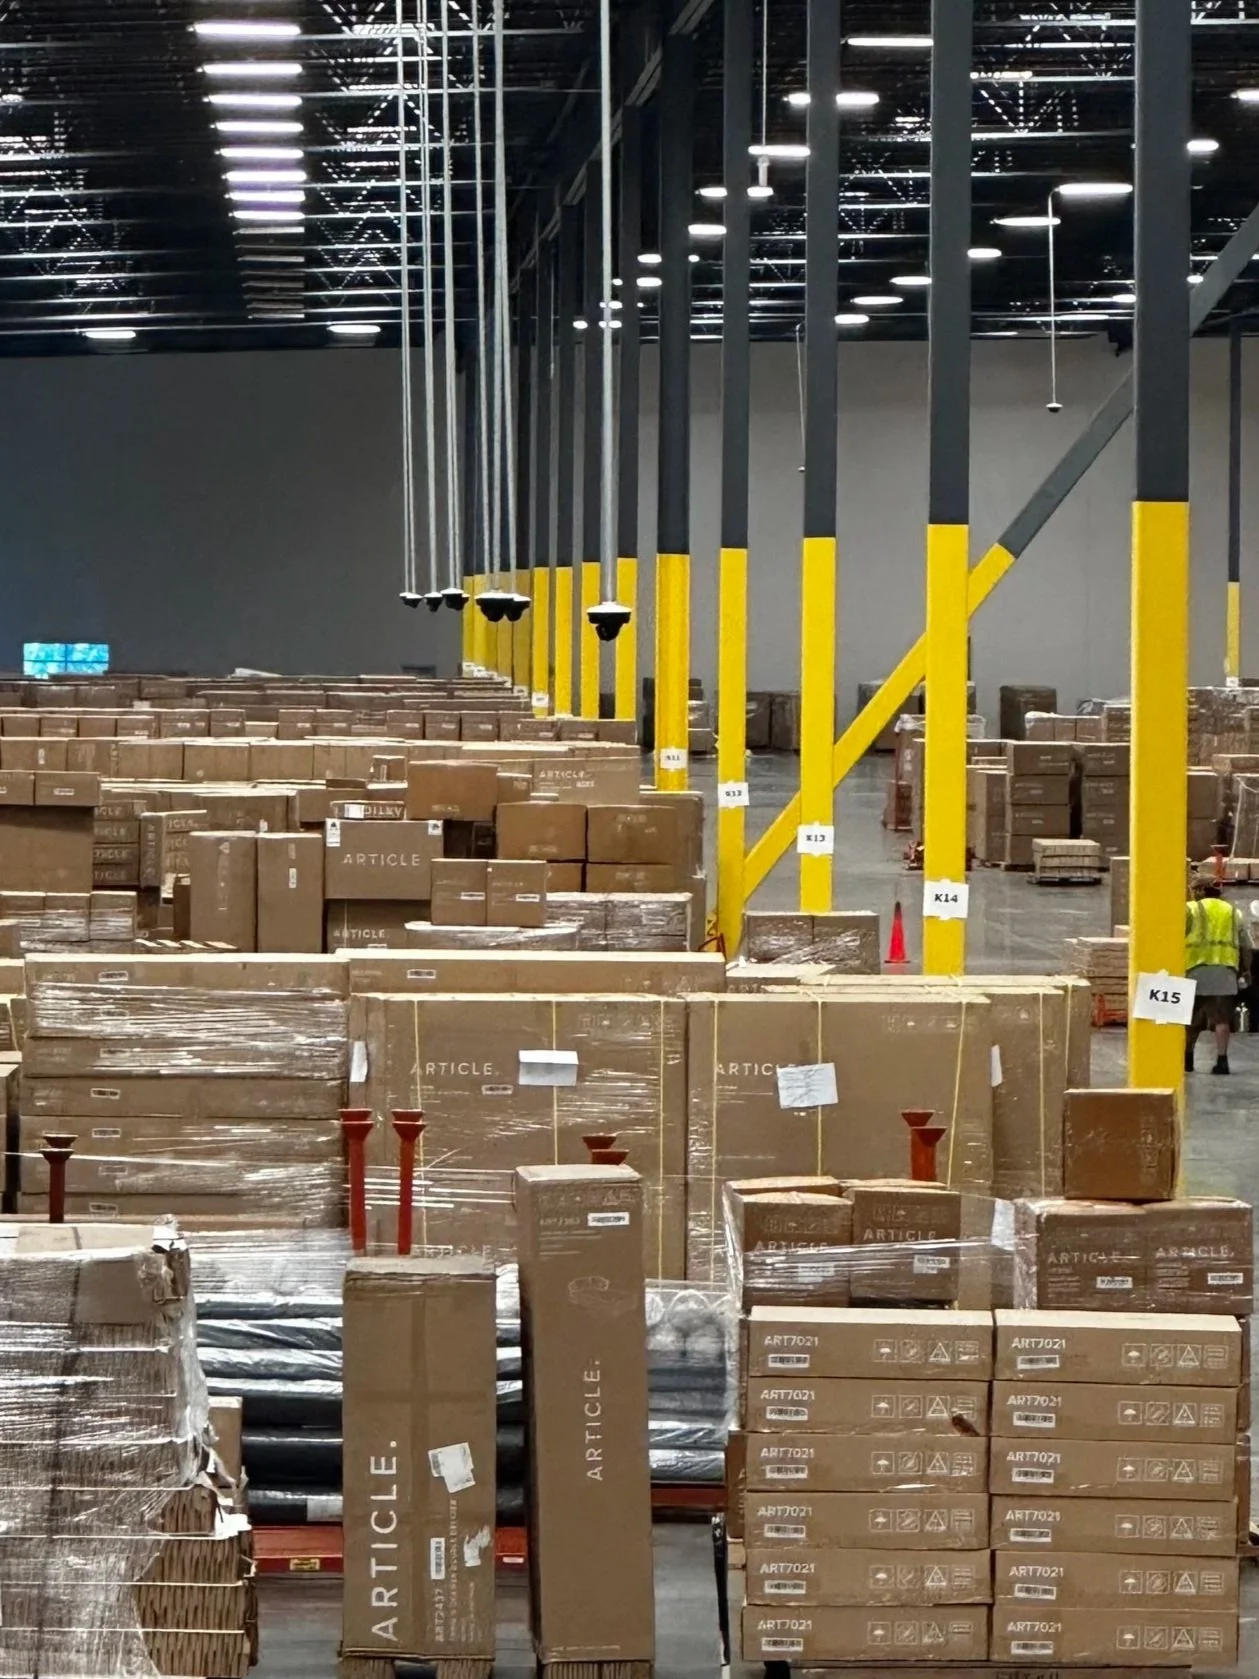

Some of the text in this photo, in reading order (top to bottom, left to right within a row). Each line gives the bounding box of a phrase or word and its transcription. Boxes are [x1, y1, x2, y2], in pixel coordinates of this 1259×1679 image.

[806, 834, 826, 843] K13
[341, 853, 421, 866] ARTICLE
[934, 893, 959, 904] K14
[1149, 988, 1181, 1004] K15
[715, 1063, 796, 1076] ARTIC
[764, 1335, 819, 1346] ART7021
[1011, 1337, 1066, 1349] ART7021
[760, 1389, 815, 1400] ART7021
[1006, 1394, 1062, 1407] ART7021
[583, 1360, 603, 1481] ARTICLE.
[760, 1447, 815, 1458] ART7021
[1006, 1451, 1061, 1464] ART7021
[757, 1505, 812, 1517] ART7021
[1005, 1509, 1060, 1521] ART7021
[370, 1440, 399, 1642] ARTICLE.
[760, 1563, 815, 1574] ART7021
[1009, 1565, 1064, 1578] ART7021
[757, 1619, 812, 1631] ART7021
[1007, 1621, 1062, 1633] ART7021
